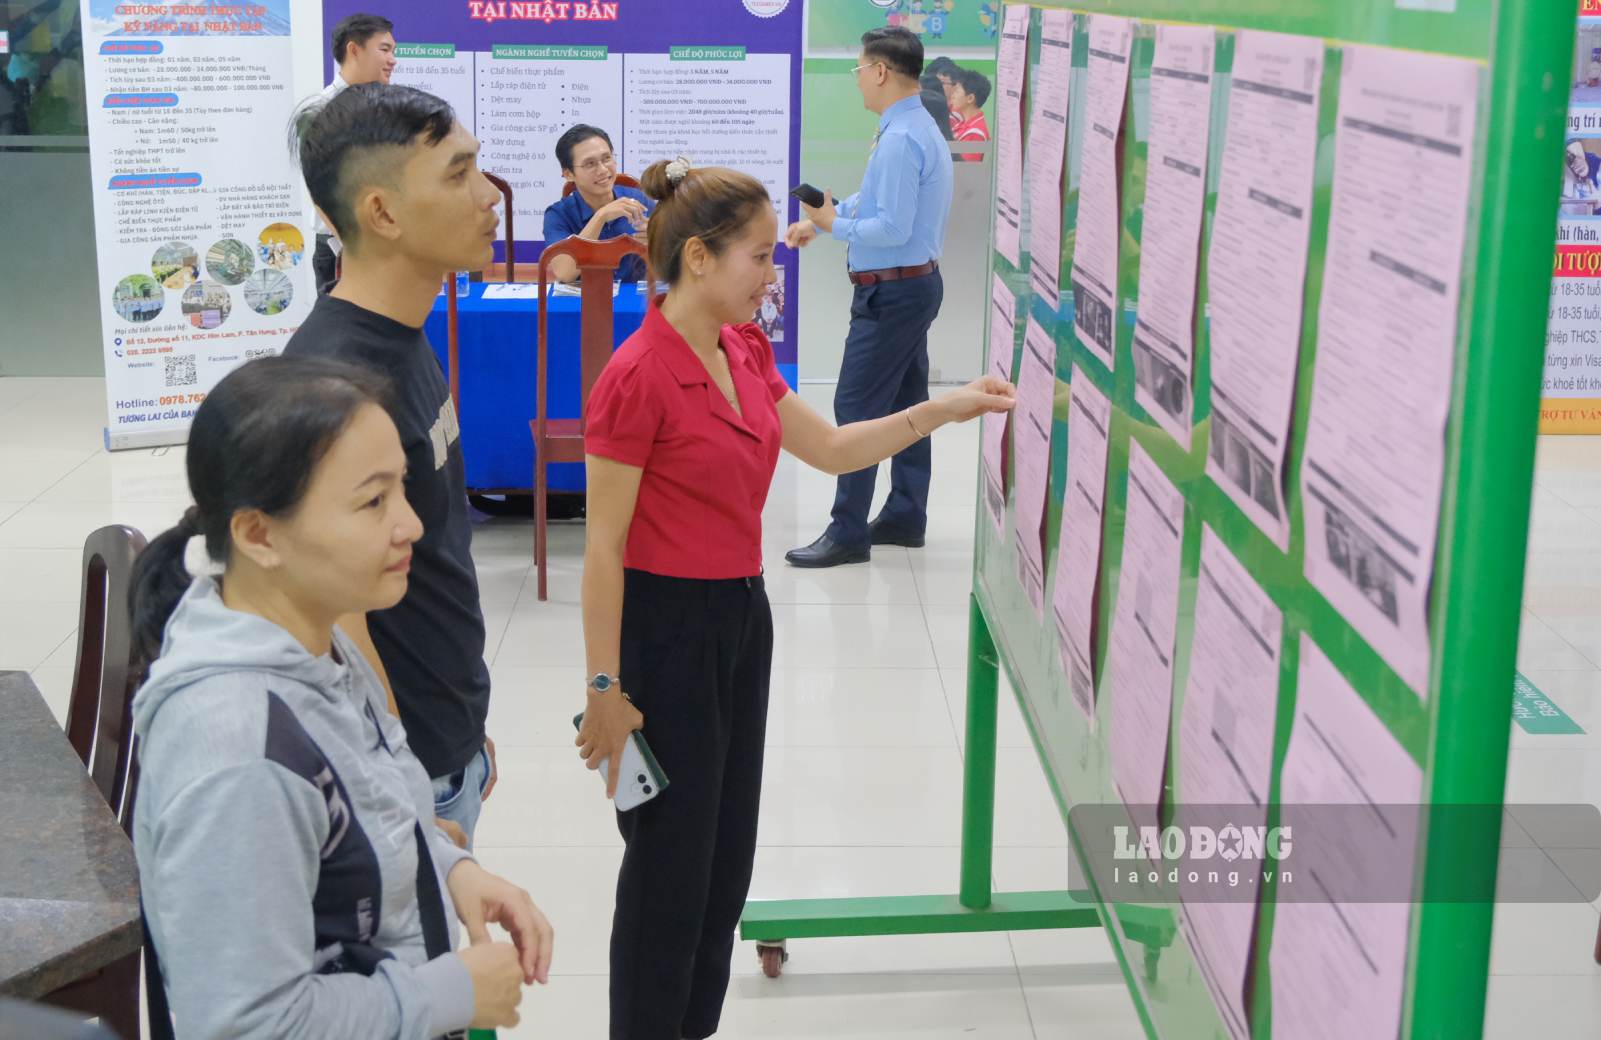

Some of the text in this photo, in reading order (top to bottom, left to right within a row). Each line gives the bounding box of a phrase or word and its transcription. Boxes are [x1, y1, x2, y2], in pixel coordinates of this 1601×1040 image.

[469, 0, 617, 22] TẠI NHẬT BẢN
[496, 48, 604, 58] NGÀNH NGHỀ TUYỂN CHỌN
[1584, 113, 1597, 128] trí
[1567, 250, 1601, 276] TƯỢ
[1561, 283, 1585, 296] 18-35
[1559, 306, 1582, 319] 18-35
[1570, 355, 1583, 366] xin
[116, 399, 158, 408] Hotline:
